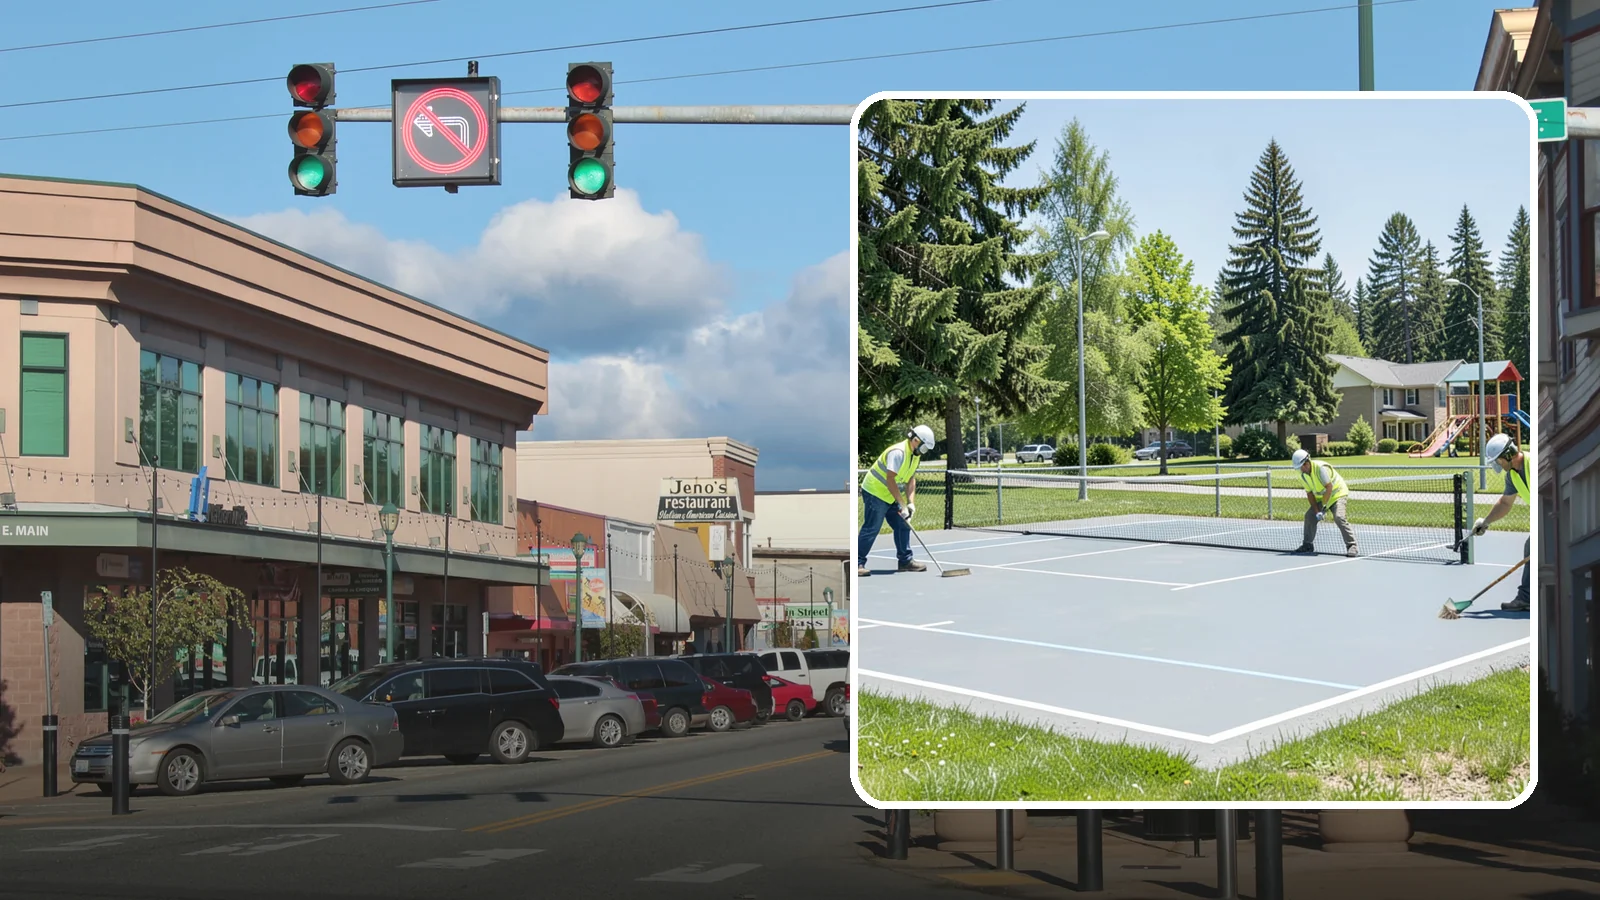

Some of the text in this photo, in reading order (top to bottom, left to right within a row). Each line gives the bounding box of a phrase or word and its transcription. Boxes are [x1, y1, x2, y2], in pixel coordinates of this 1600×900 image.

[669, 480, 727, 494] Jeno's
[665, 496, 731, 509] restaurant
[658, 510, 682, 519] Italian
[686, 509, 714, 519] American
[714, 509, 738, 519] Cuisine
[2, 525, 49, 536] E. MAIN
[797, 608, 829, 617] Street
